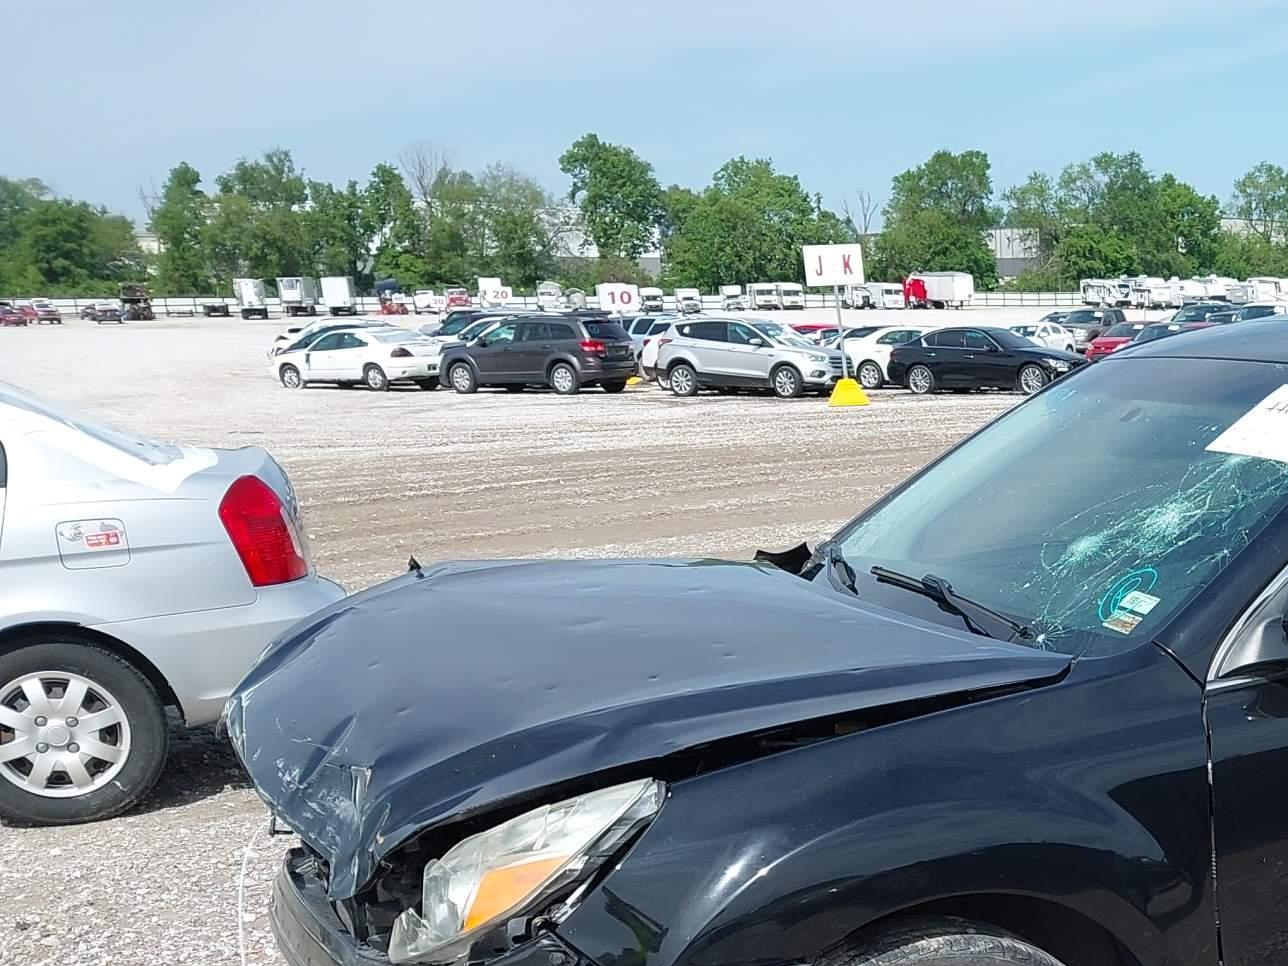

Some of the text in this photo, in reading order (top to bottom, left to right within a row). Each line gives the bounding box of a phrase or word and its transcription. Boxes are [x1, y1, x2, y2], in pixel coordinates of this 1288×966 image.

[815, 254, 853, 276] J K
[492, 290, 509, 299] 20
[607, 290, 632, 305] 10
